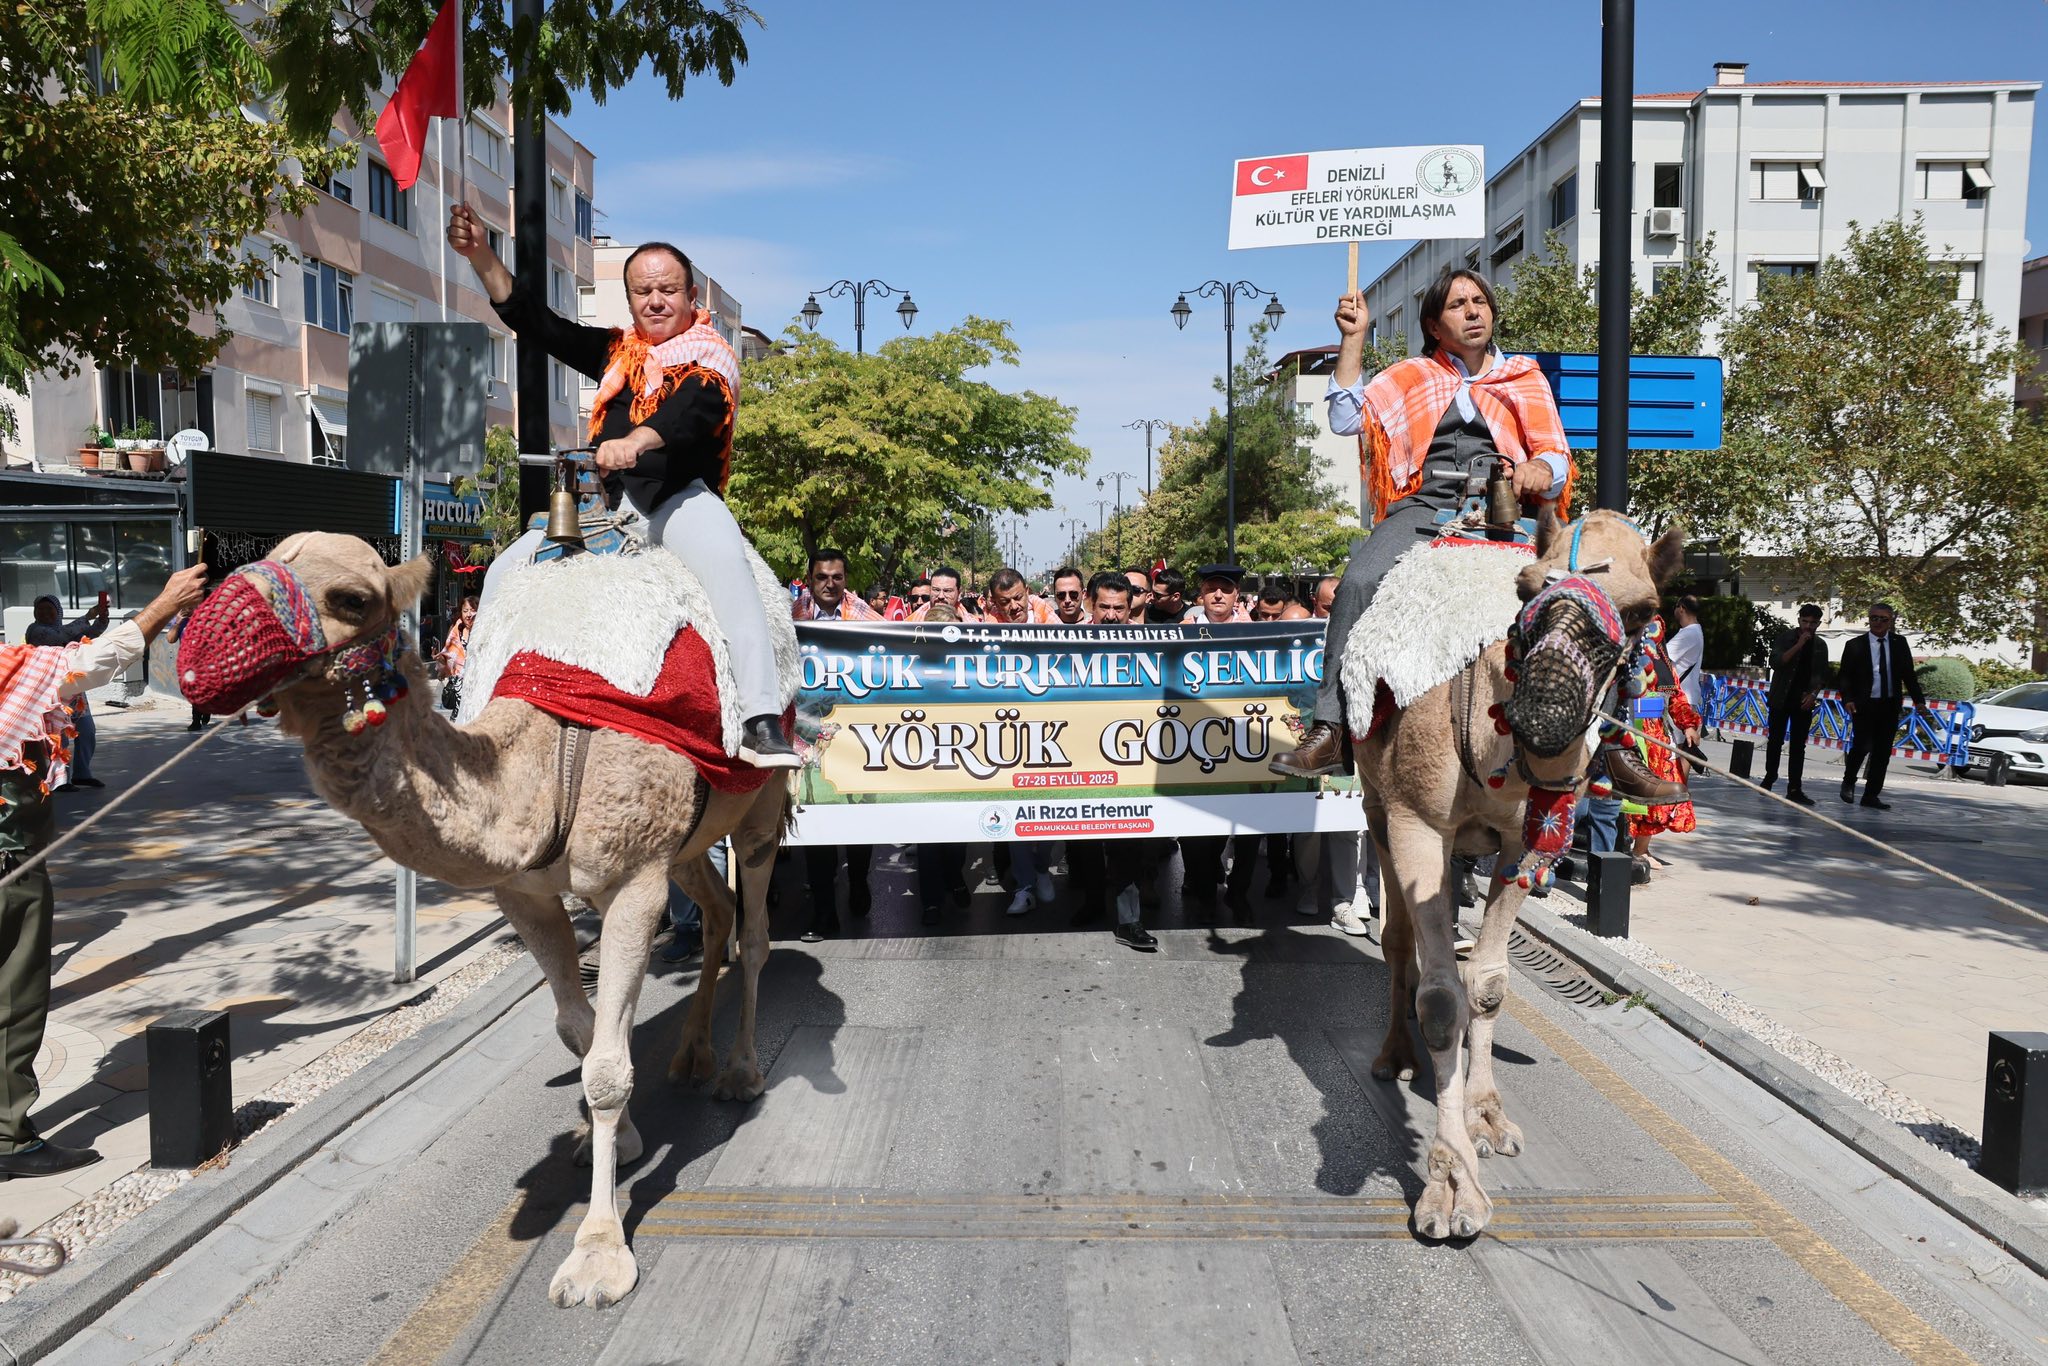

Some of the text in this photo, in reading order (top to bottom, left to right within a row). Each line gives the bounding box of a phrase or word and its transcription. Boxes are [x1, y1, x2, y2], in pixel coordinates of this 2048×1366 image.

[1327, 163, 1385, 183] DENİZLİ
[1291, 184, 1418, 206] EFELERİ YÖRÜKLERİ
[1255, 203, 1456, 227] KÜLTÜR VE YARDIMLAŞMA
[1317, 220, 1392, 239] DERNEĞİ
[425, 498, 481, 523] HOCOLA
[966, 627, 1185, 643] T.C. PAMUKKALE BELEDİYESİ
[1183, 639, 1326, 692] ŞENLİĞ
[848, 703, 1274, 780] YÖRÜK GÖÇÜ
[1017, 772, 1115, 787] 27-28 EYLÜL 2025
[1015, 804, 1153, 820] Ali Rıza Ertemur
[1034, 824, 1079, 832] PAMUKKALE
[1081, 822, 1117, 831] BELEDİYE
